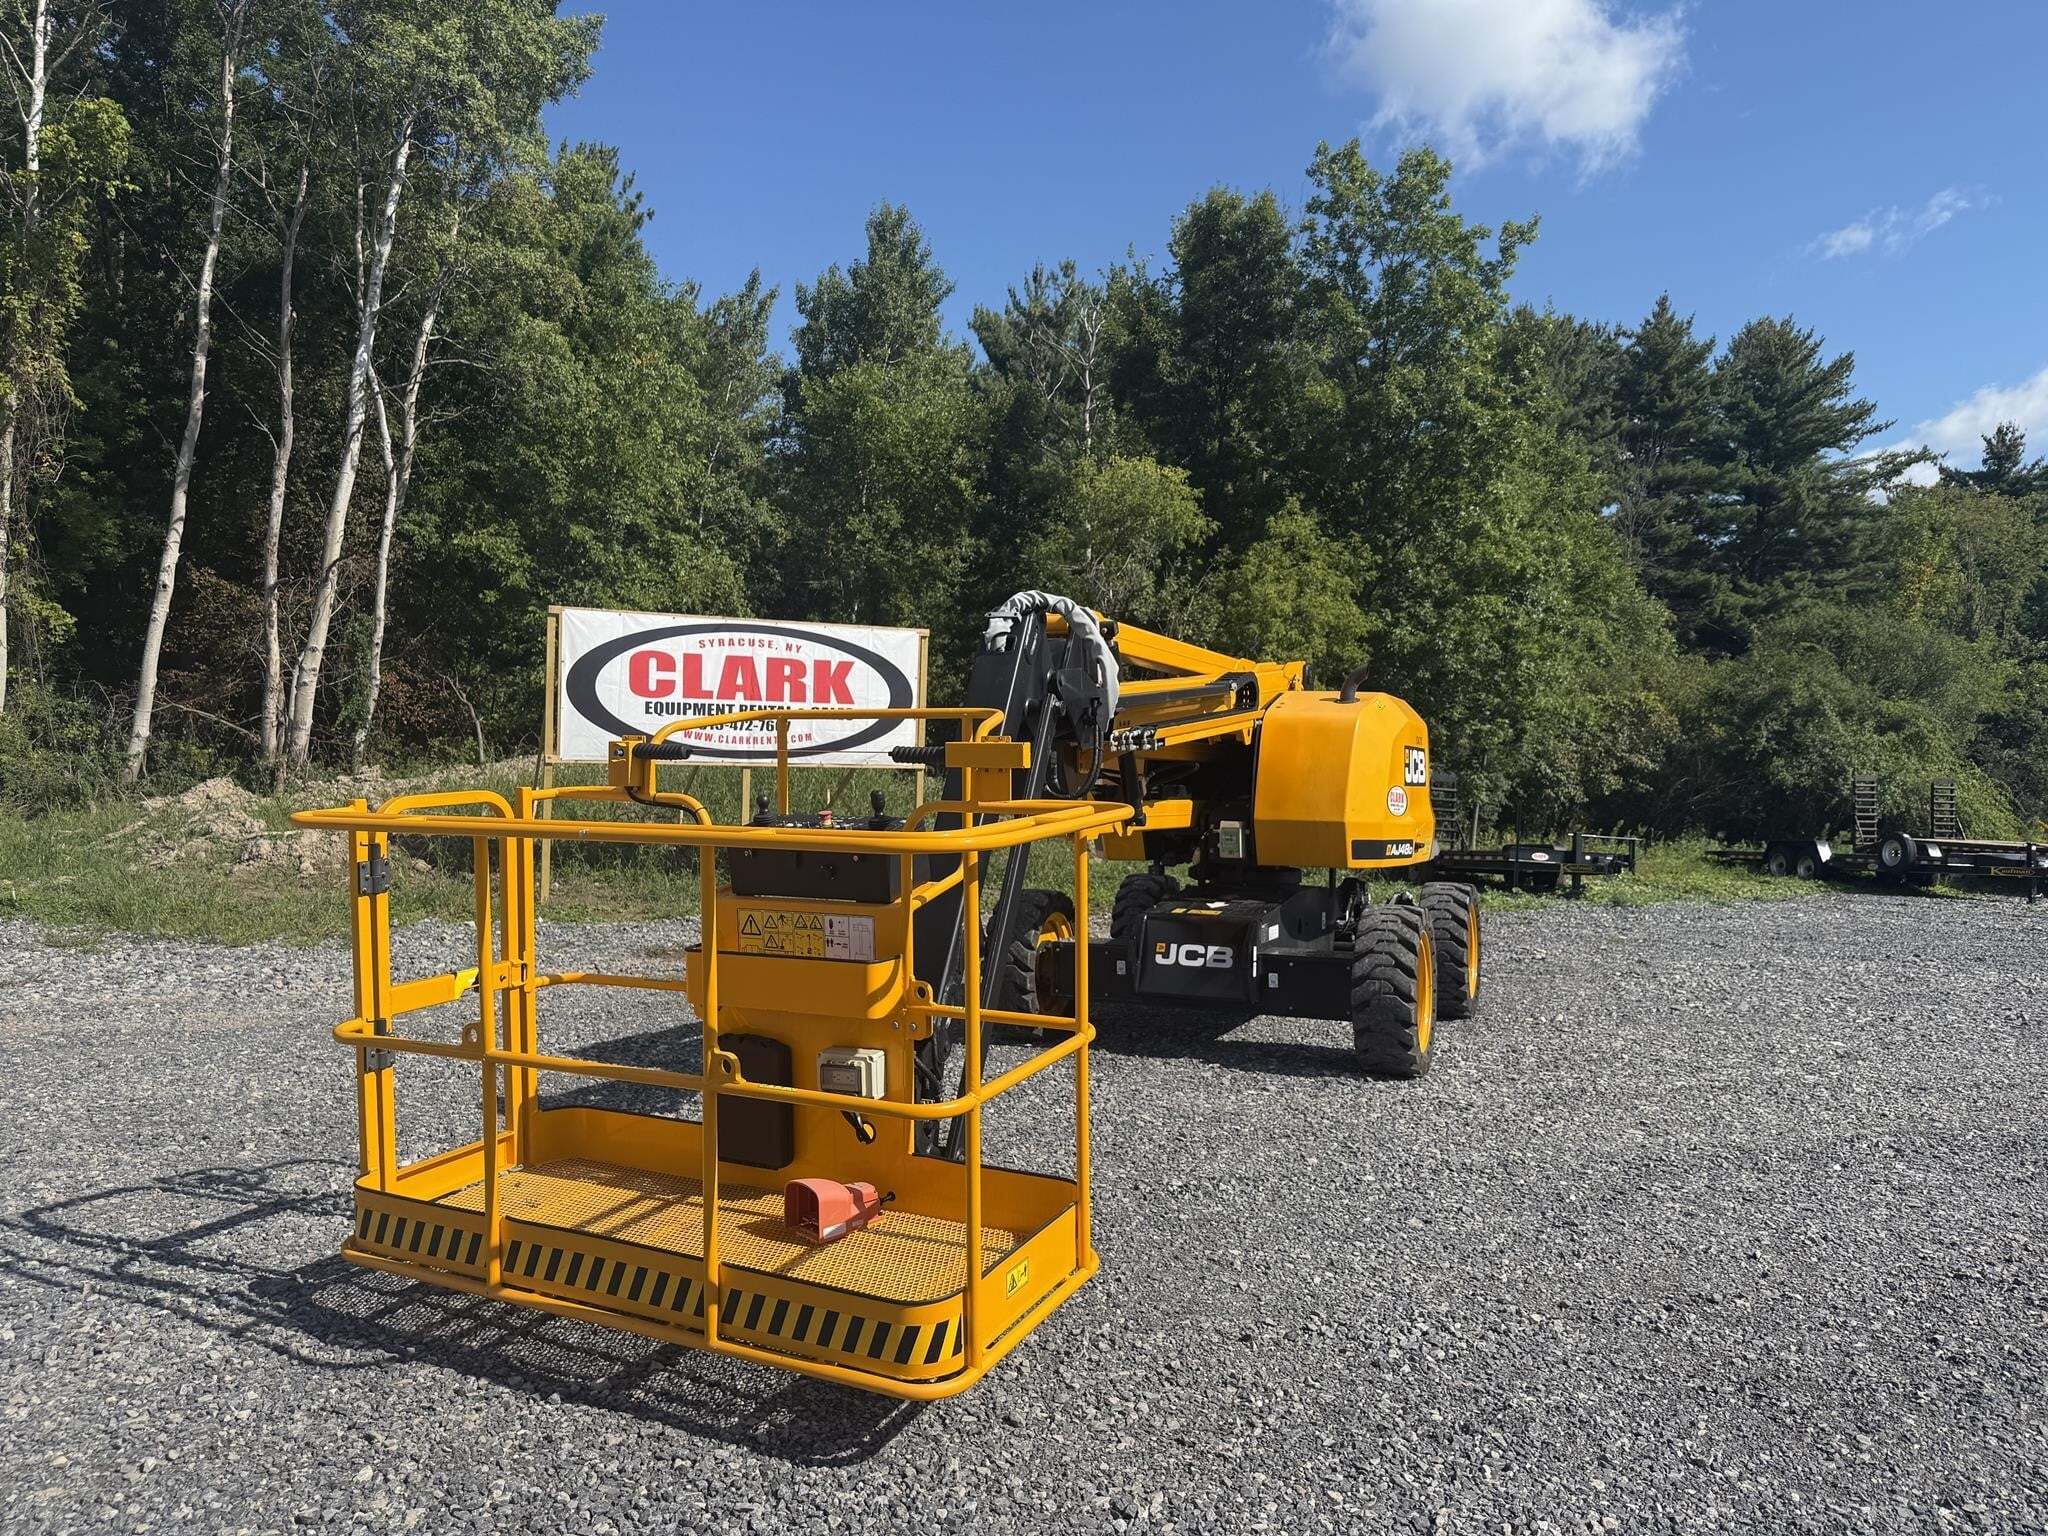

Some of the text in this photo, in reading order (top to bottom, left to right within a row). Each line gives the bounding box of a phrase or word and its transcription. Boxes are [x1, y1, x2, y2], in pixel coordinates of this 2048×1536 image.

[698, 638, 802, 653] SYRACUSE, NY
[629, 650, 855, 705] CLARK
[645, 701, 735, 717] EQUIPMENT
[1405, 749, 1425, 783] JCB
[1154, 942, 1234, 969] JCB
